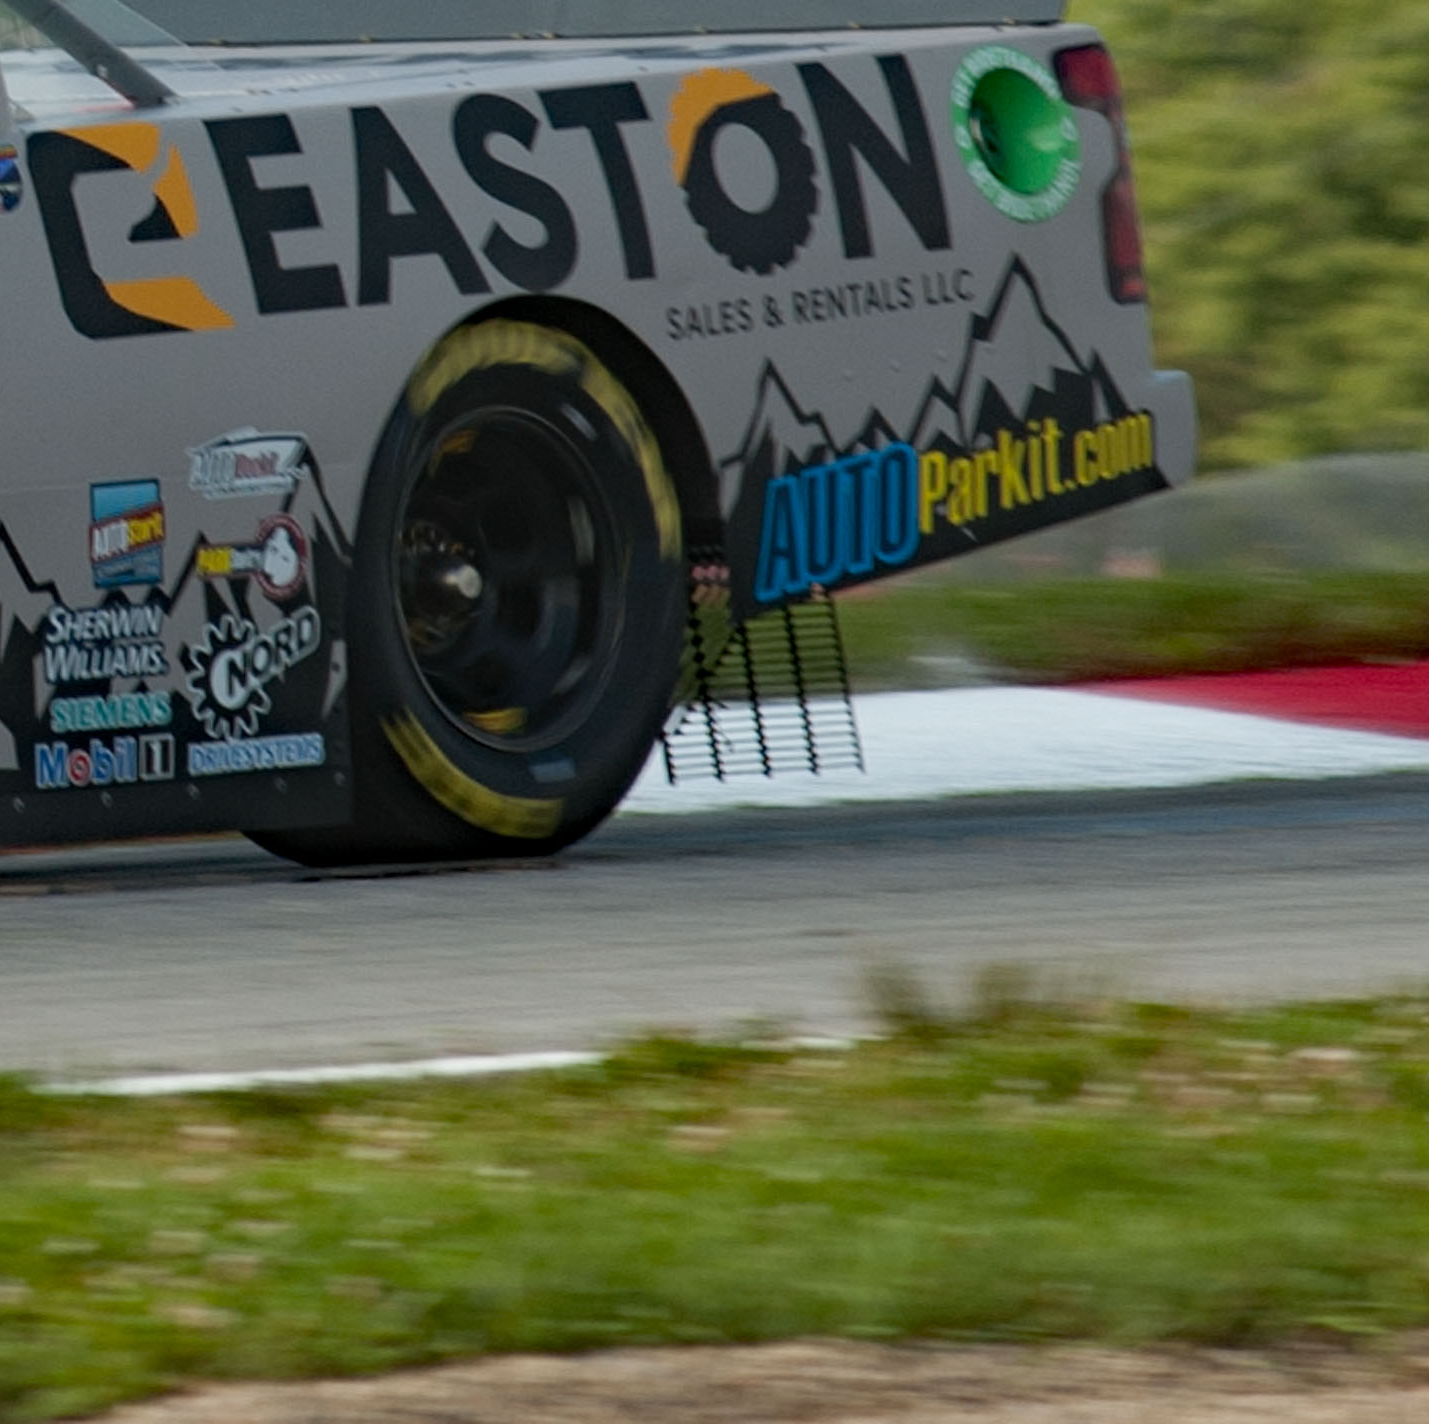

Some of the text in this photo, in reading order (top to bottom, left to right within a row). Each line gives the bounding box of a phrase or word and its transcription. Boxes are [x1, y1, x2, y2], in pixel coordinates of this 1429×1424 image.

[205, 55, 951, 315] EASTON
[666, 268, 974, 341] SALES & RENTALS LLC
[754, 412, 1153, 603] AUTOParkit.com
[45, 606, 162, 645] SHERWIN
[217, 606, 319, 707] NORD
[45, 644, 165, 683] WILLIAMS
[52, 692, 171, 732] SIEMENS
[36, 737, 138, 789] Mobil
